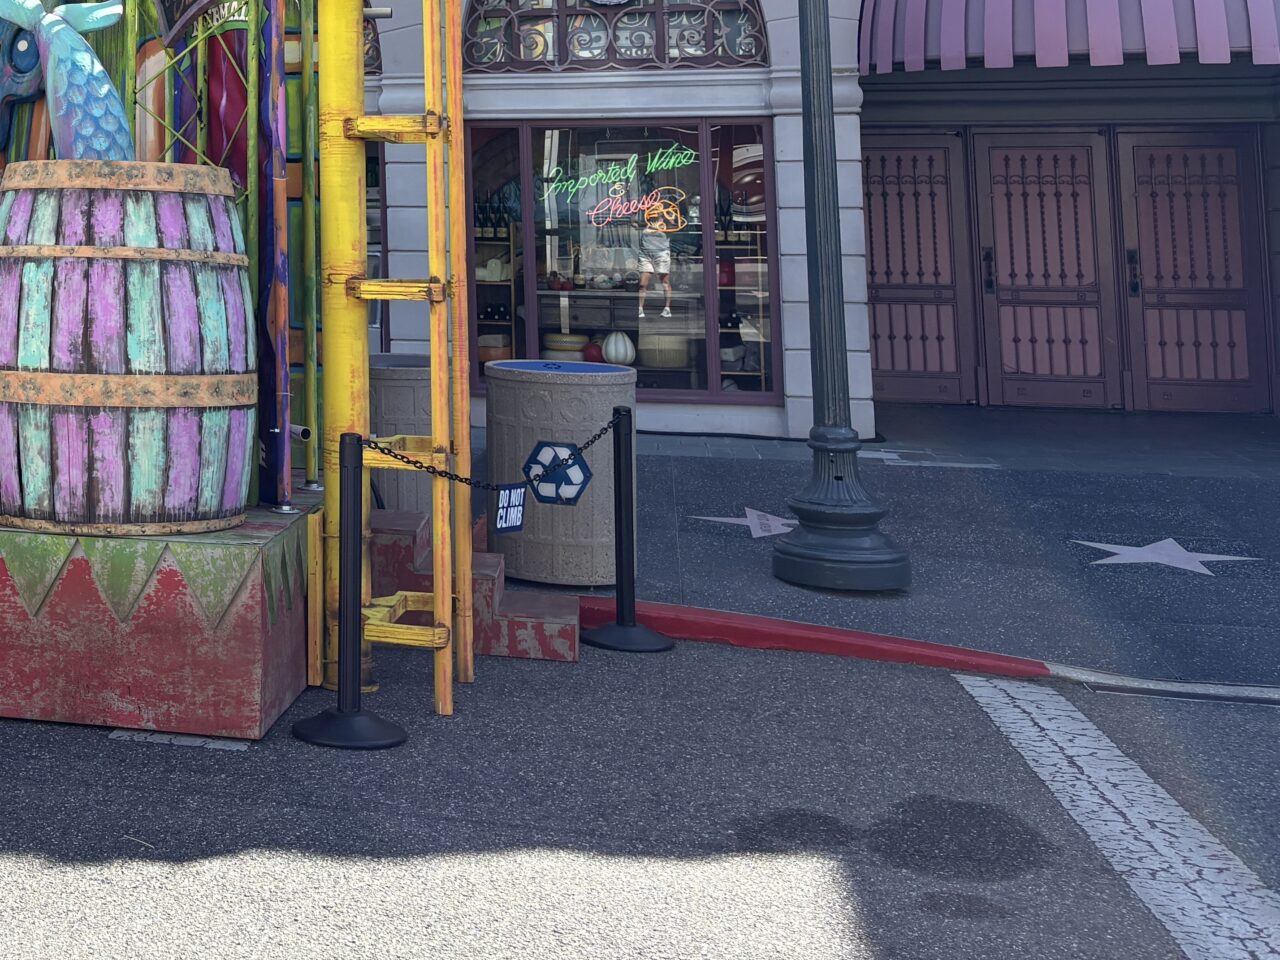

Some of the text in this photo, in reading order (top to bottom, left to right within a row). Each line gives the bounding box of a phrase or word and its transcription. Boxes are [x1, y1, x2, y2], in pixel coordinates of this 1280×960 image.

[539, 143, 695, 204] Imported Wine
[586, 190, 661, 227] Cheese
[499, 487, 525, 508] DO NOT
[496, 506, 523, 529] CLIMB
